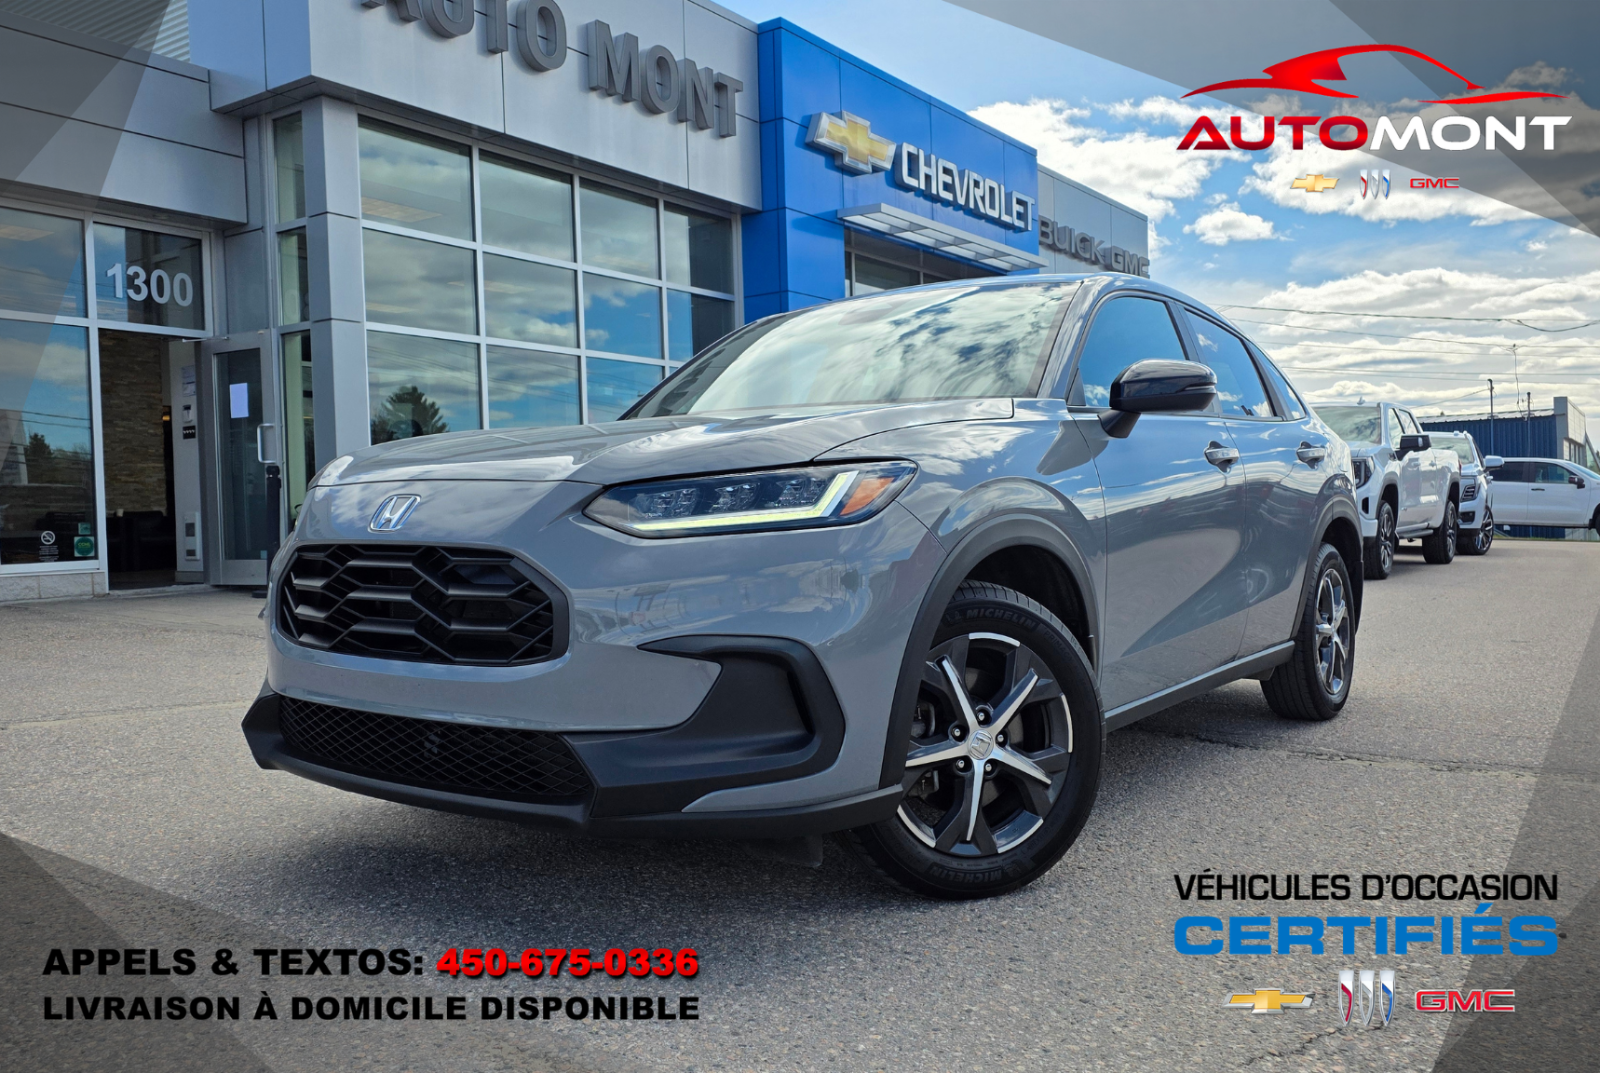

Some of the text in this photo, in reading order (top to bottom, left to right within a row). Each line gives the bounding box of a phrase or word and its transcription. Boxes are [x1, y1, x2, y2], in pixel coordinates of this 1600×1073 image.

[361, 0, 743, 137] UTO MONT
[898, 141, 1036, 232] CHEVROLET
[1039, 214, 1150, 279] BUICK GMC
[106, 262, 194, 307] 1300
[965, 607, 1036, 631] MICHELIN
[928, 865, 1003, 884] MICHELIN
